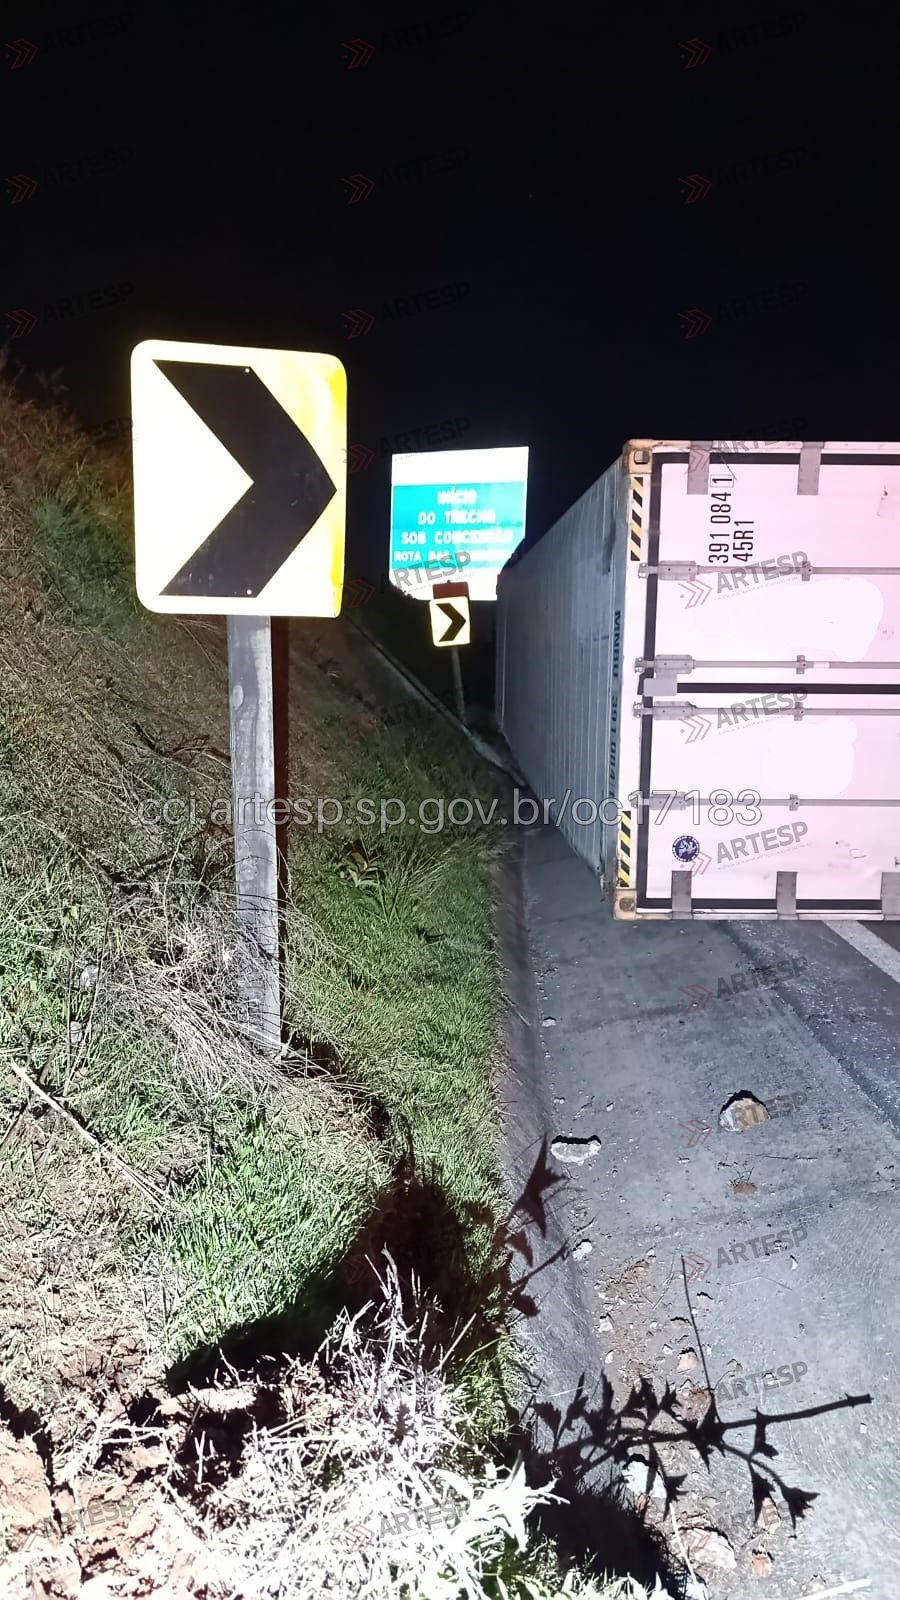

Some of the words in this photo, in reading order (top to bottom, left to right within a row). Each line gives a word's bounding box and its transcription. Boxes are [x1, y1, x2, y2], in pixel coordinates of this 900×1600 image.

[418, 512, 436, 525] DO
[710, 492, 732, 524] 084
[394, 551, 421, 561] ROTA
[708, 533, 730, 563] 391
[733, 520, 754, 562] 45R1
